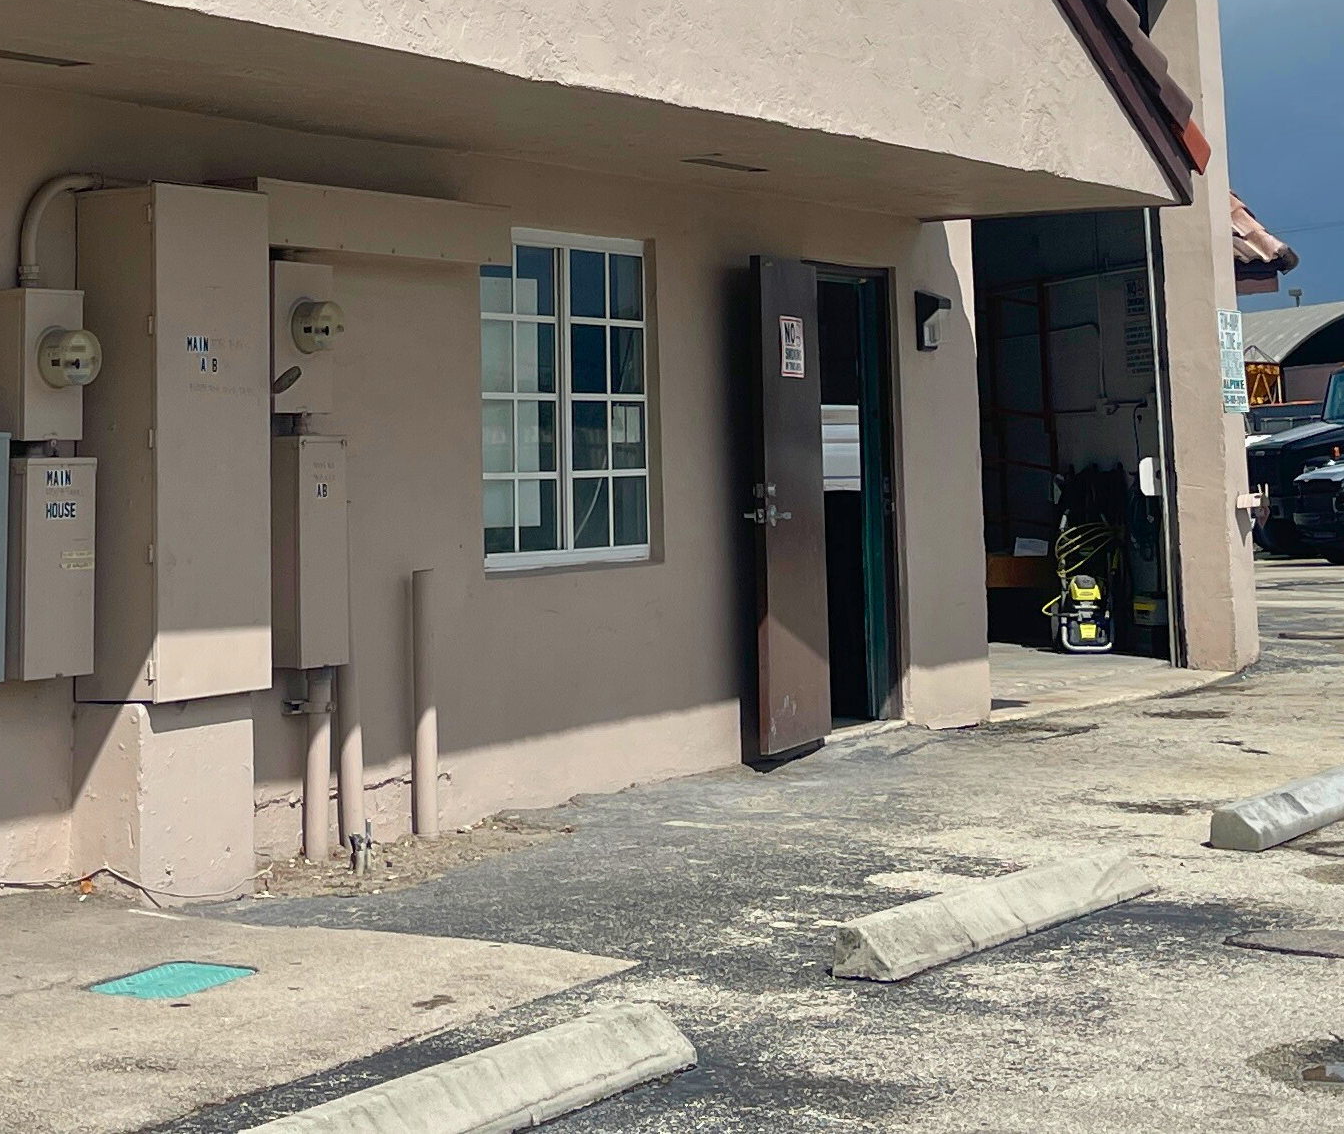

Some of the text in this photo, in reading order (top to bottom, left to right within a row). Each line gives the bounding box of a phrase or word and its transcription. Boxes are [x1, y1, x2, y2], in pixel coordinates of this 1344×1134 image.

[784, 322, 795, 344] NO
[186, 336, 209, 352] MAIN
[200, 357, 218, 373] A B
[46, 469, 72, 486] MAIN
[316, 483, 328, 498] AB
[46, 502, 76, 519] HOUSE
